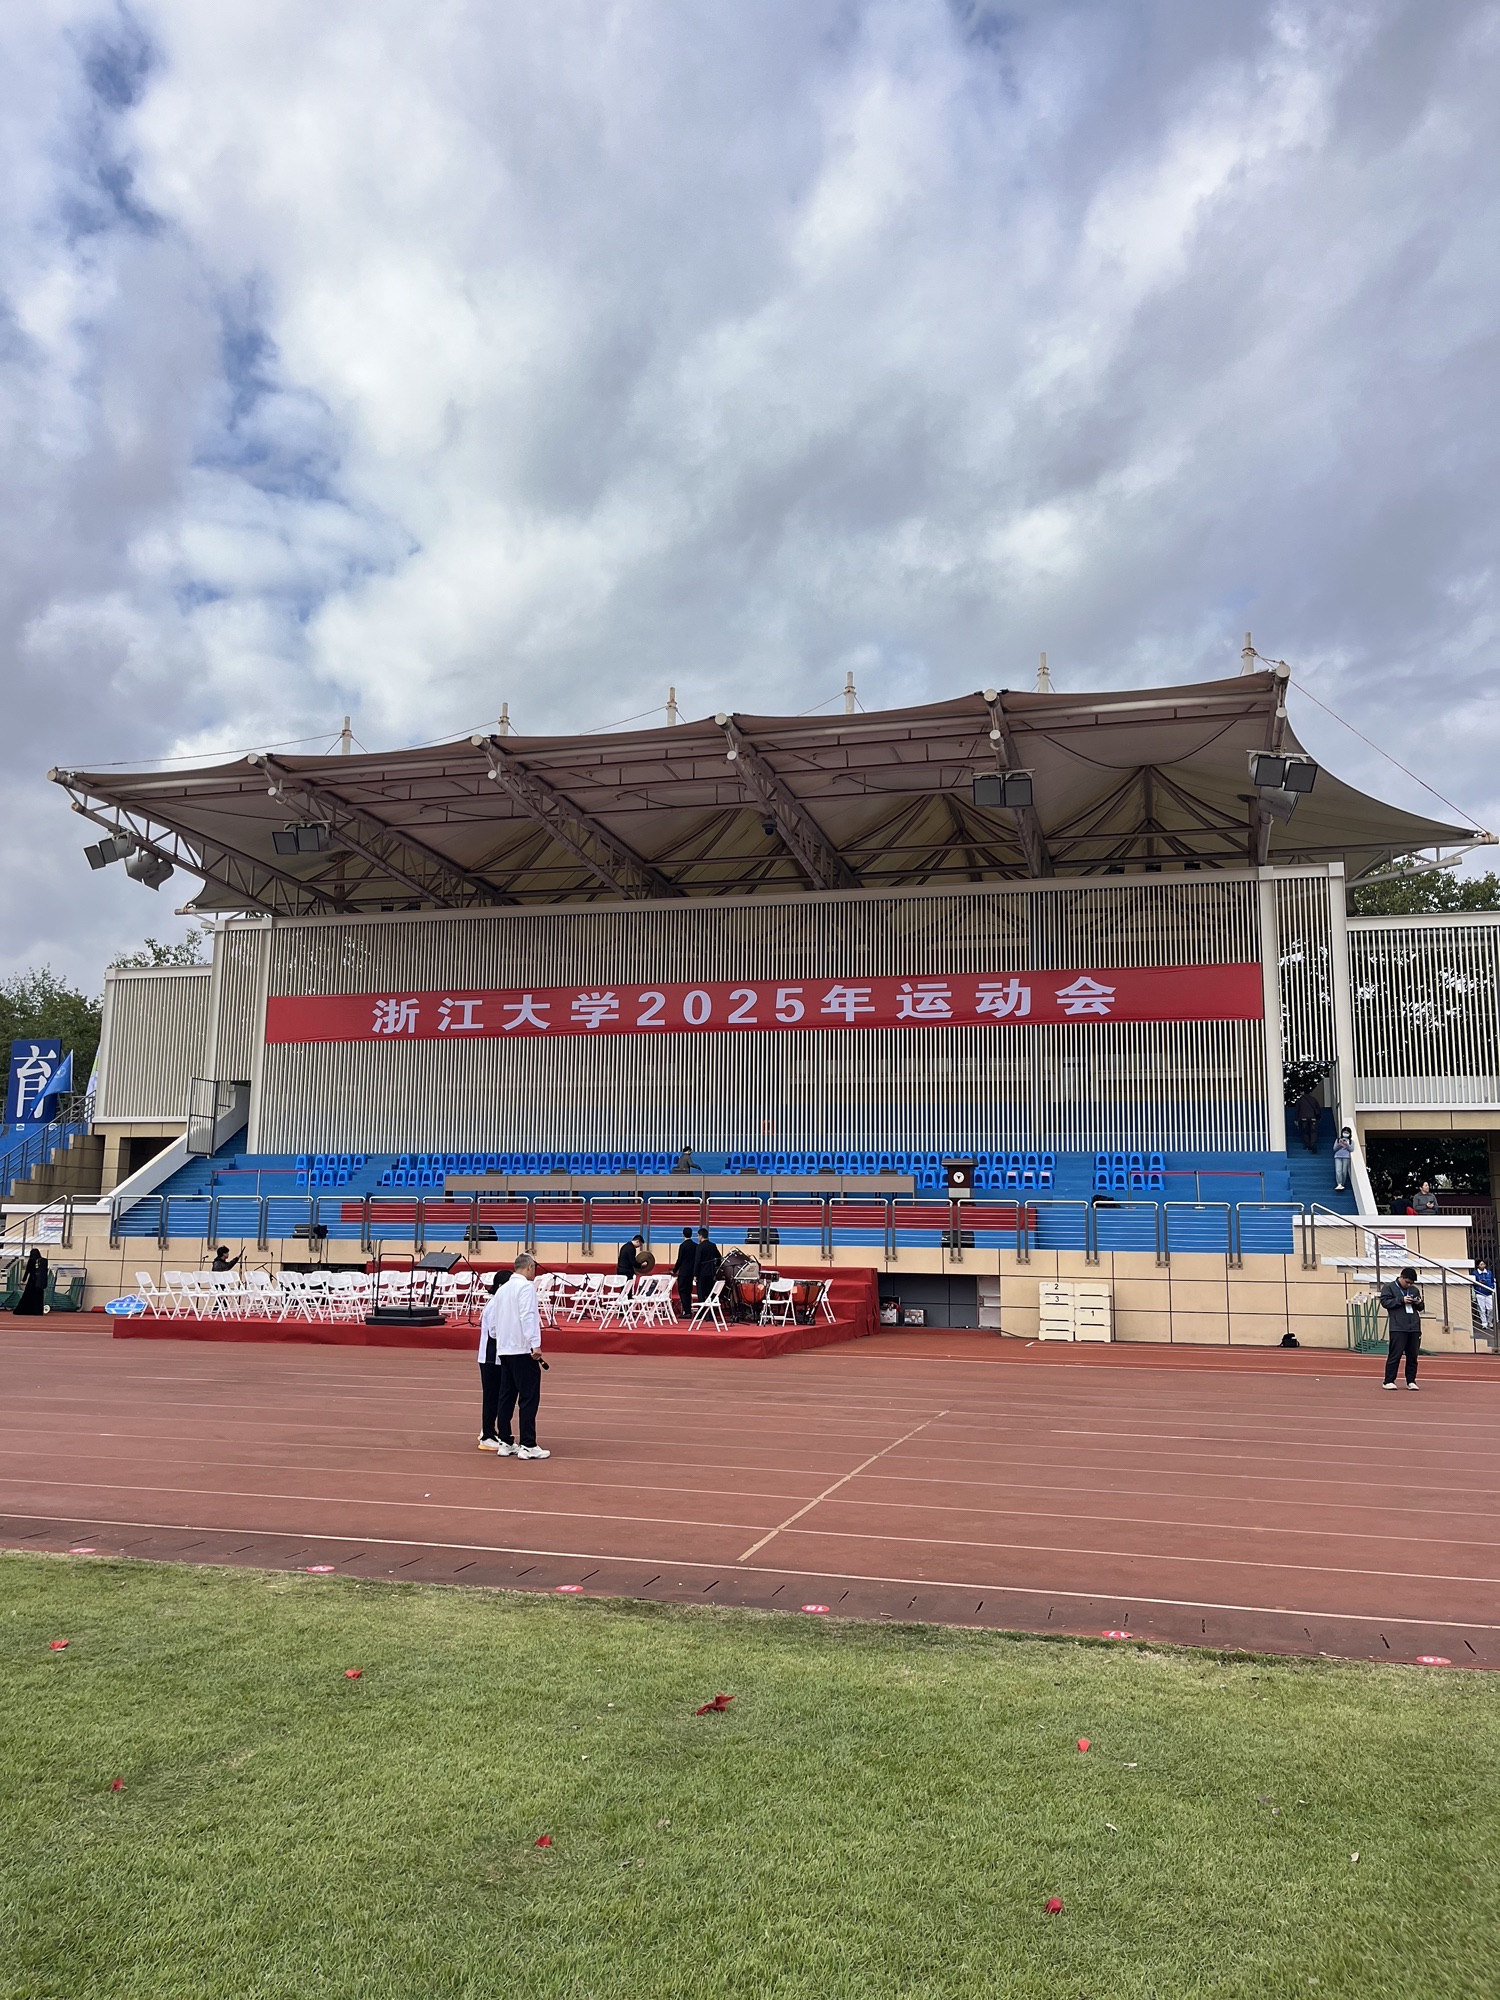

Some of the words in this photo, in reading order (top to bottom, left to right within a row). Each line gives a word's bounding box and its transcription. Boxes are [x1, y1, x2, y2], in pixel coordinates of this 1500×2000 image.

[371, 976, 1118, 1035] 浙江大学2025年运动会
[13, 1045, 57, 1119] 育
